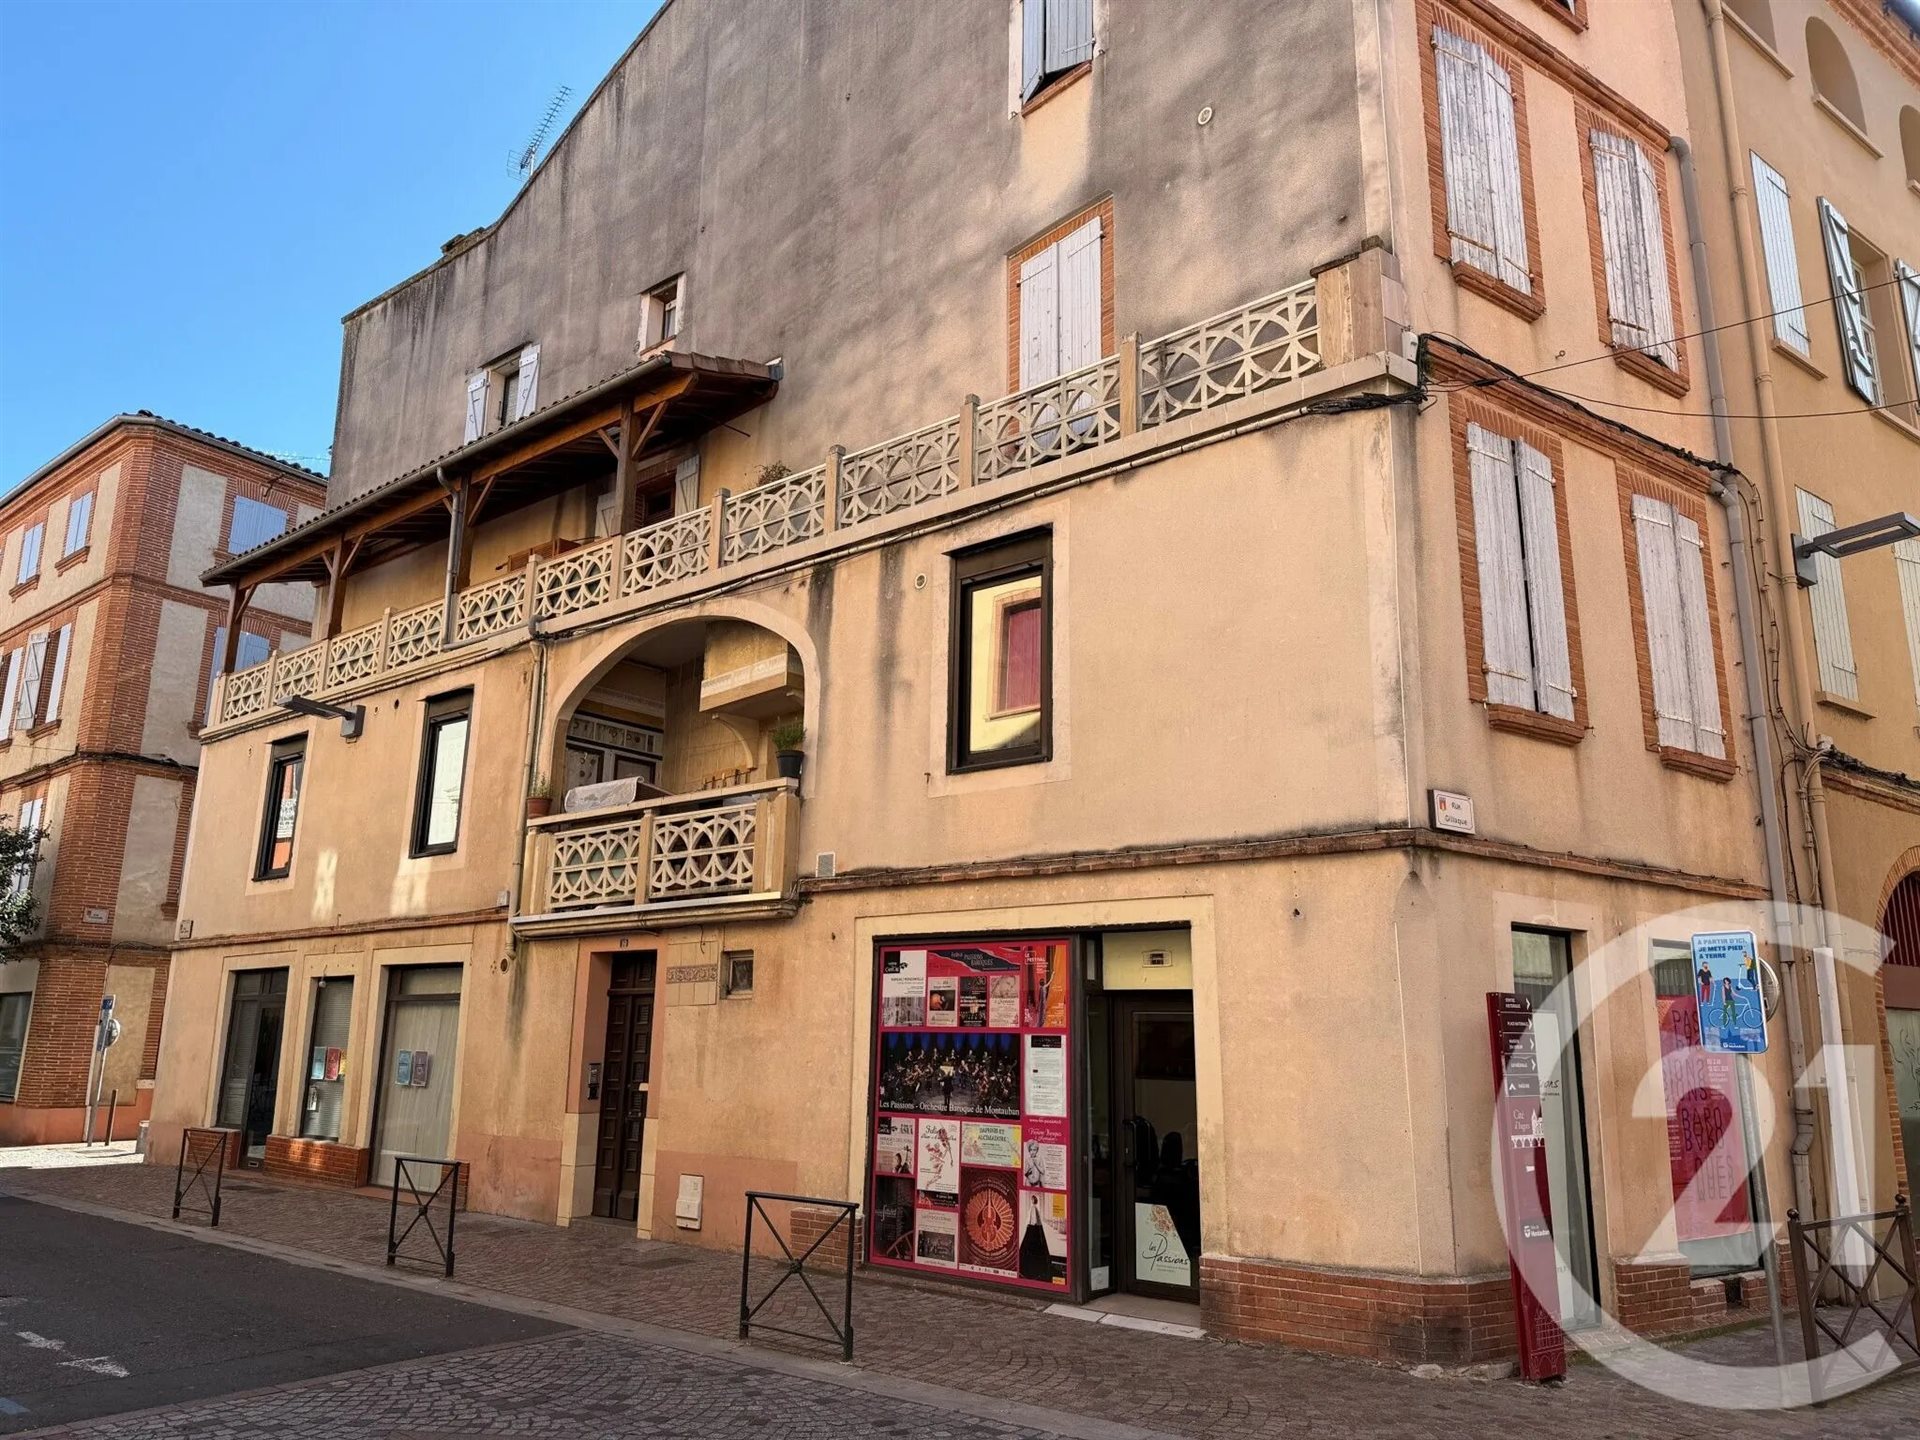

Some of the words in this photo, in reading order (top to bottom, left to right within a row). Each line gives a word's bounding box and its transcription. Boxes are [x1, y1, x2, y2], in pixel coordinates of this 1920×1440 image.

[879, 1100, 889, 1108] Les
[890, 1100, 915, 1109] Passions
[919, 1101, 948, 1112] Orchestre
[949, 1102, 974, 1114] Baroque
[975, 1104, 983, 1113] de
[984, 1105, 1020, 1116] Montauban
[1142, 1233, 1189, 1272] Passions
